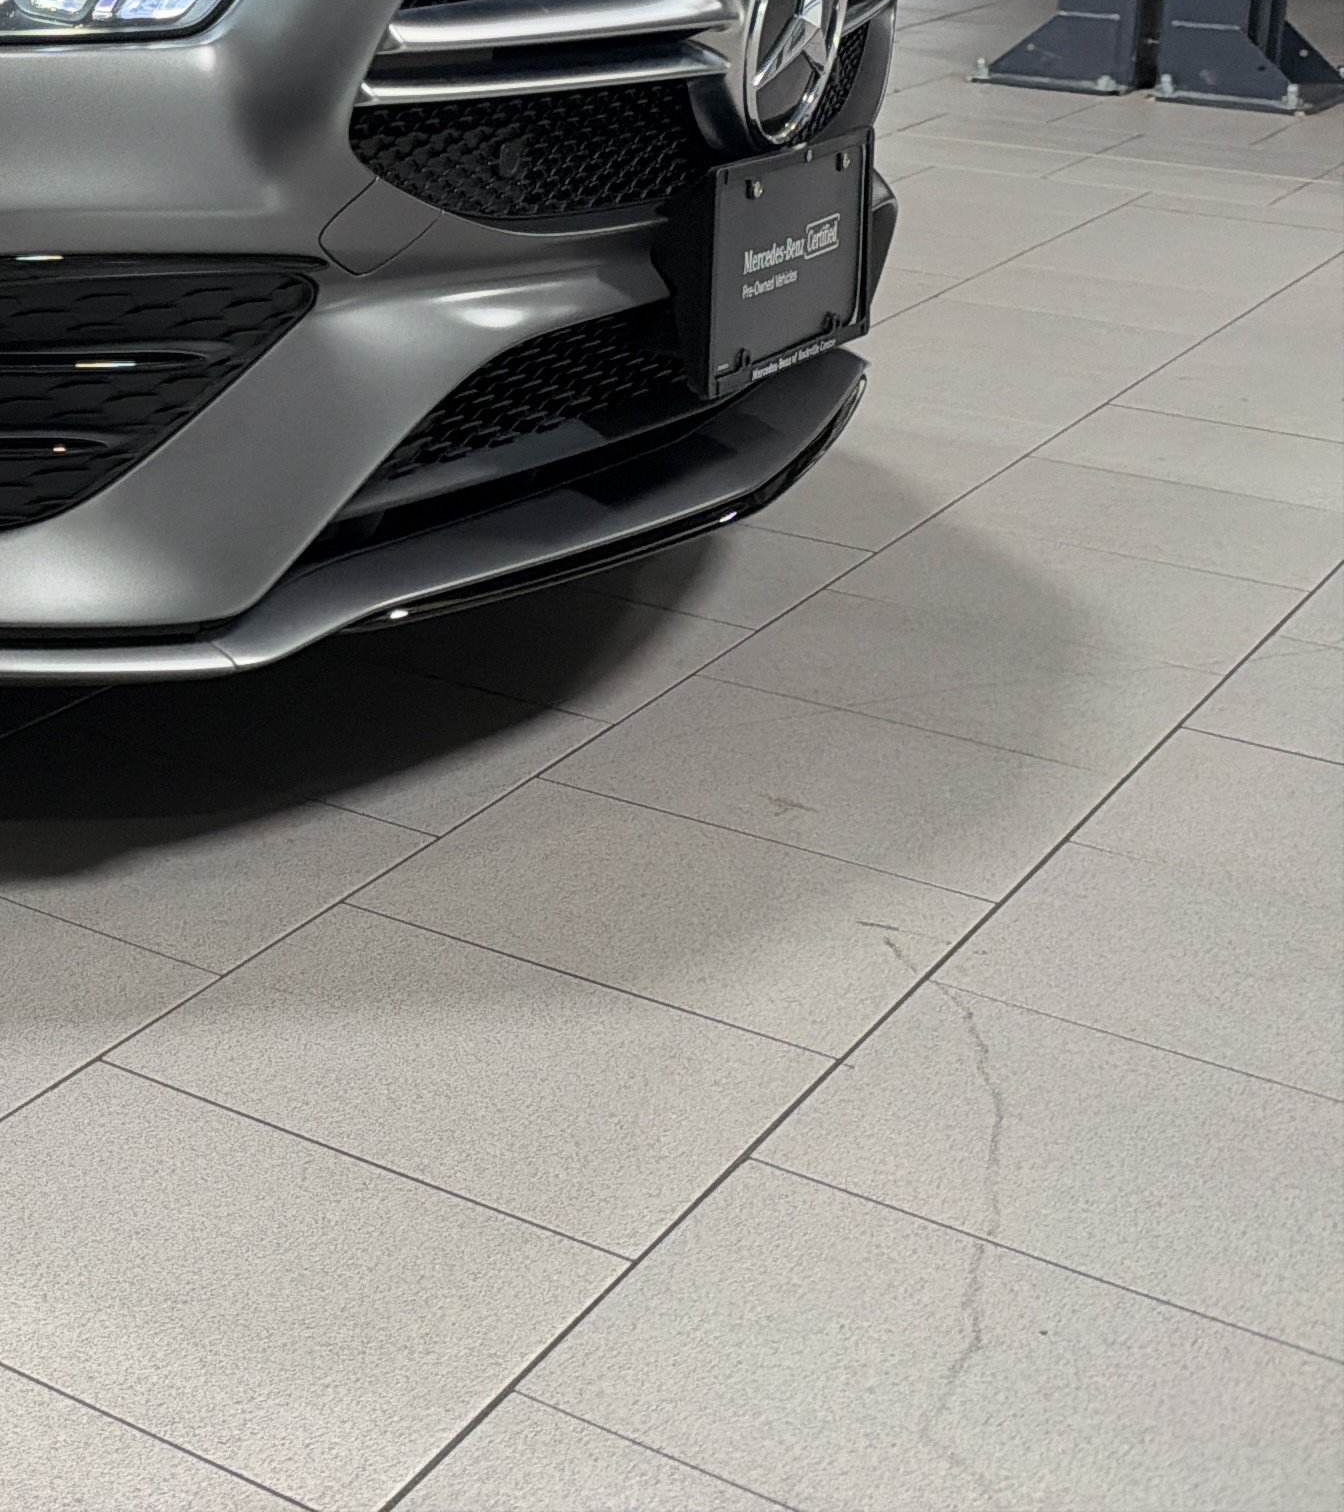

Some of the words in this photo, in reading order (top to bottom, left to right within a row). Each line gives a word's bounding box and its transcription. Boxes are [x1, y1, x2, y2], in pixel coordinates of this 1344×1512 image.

[743, 237, 805, 275] Mercedes-Benz
[807, 220, 838, 252] Certified
[742, 276, 775, 300] Pre-Owned
[775, 269, 798, 288] Vehicles
